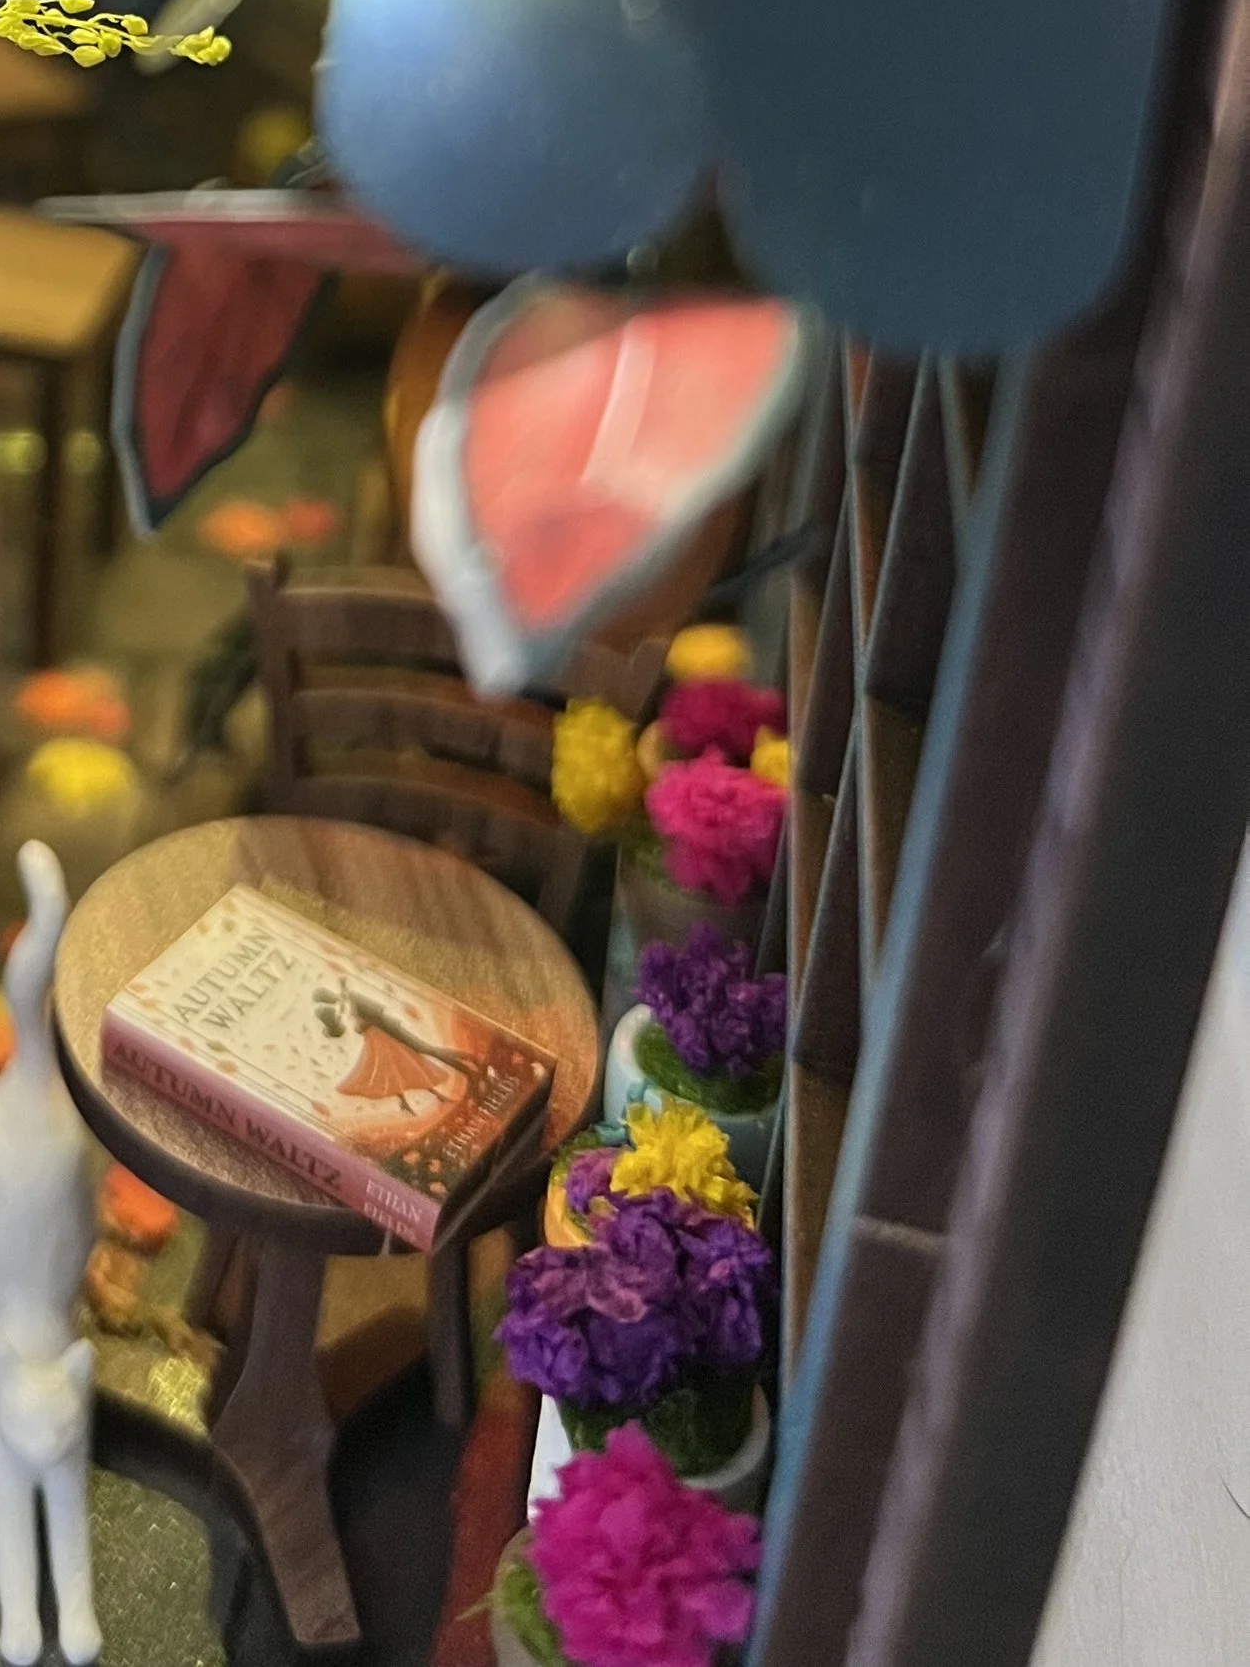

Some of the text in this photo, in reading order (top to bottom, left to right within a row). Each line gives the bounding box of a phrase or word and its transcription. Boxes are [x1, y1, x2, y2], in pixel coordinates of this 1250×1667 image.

[174, 925, 278, 1026] AUTUMN
[201, 947, 298, 1032] WALTZ
[113, 1040, 343, 1193] AUTUMN WALTZ
